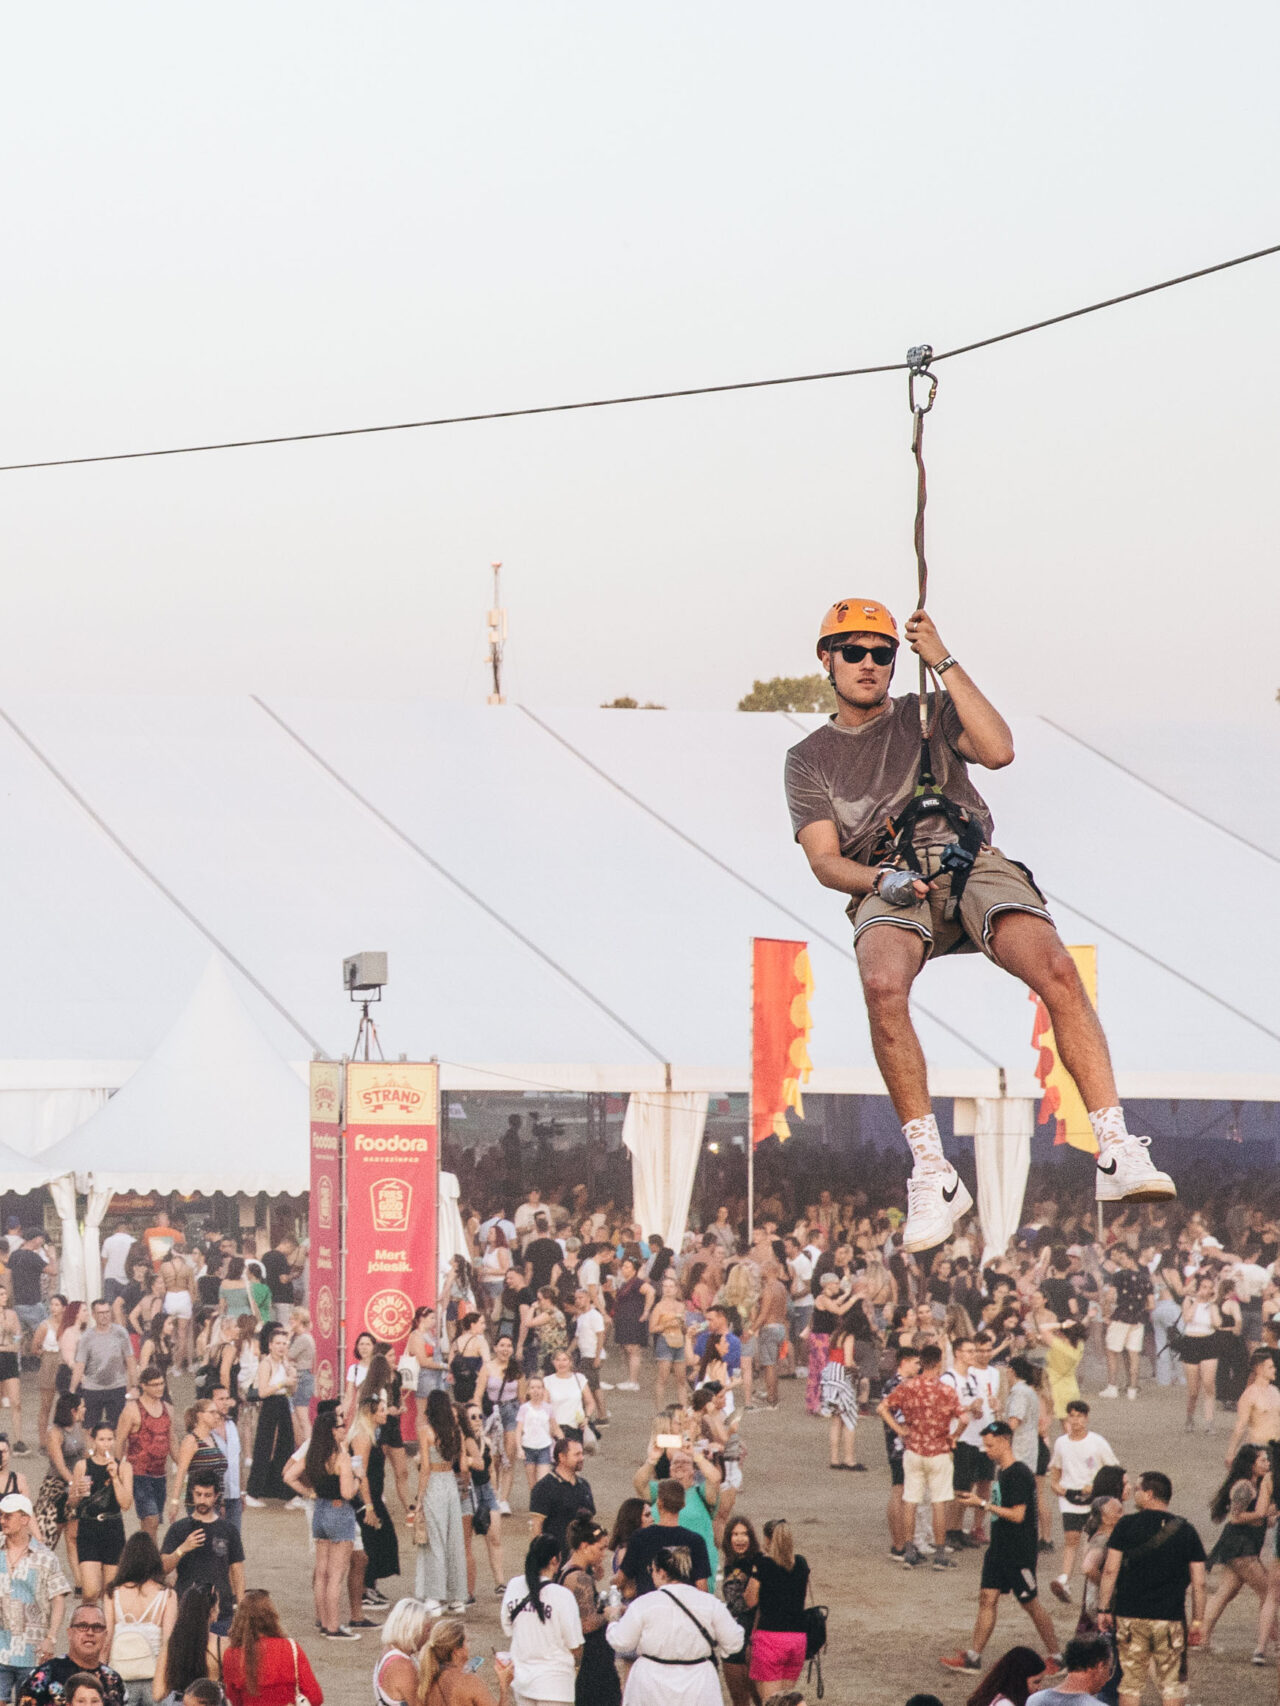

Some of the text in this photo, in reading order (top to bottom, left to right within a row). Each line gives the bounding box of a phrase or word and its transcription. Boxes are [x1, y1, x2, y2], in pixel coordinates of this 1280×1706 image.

[363, 1089, 421, 1105] STRAND
[354, 1134, 428, 1152] foodora
[375, 1249, 407, 1261] Mert
[367, 1261, 413, 1274] jólesik.
[372, 1296, 408, 1314] DONUT
[372, 1317, 408, 1336] WORRY
